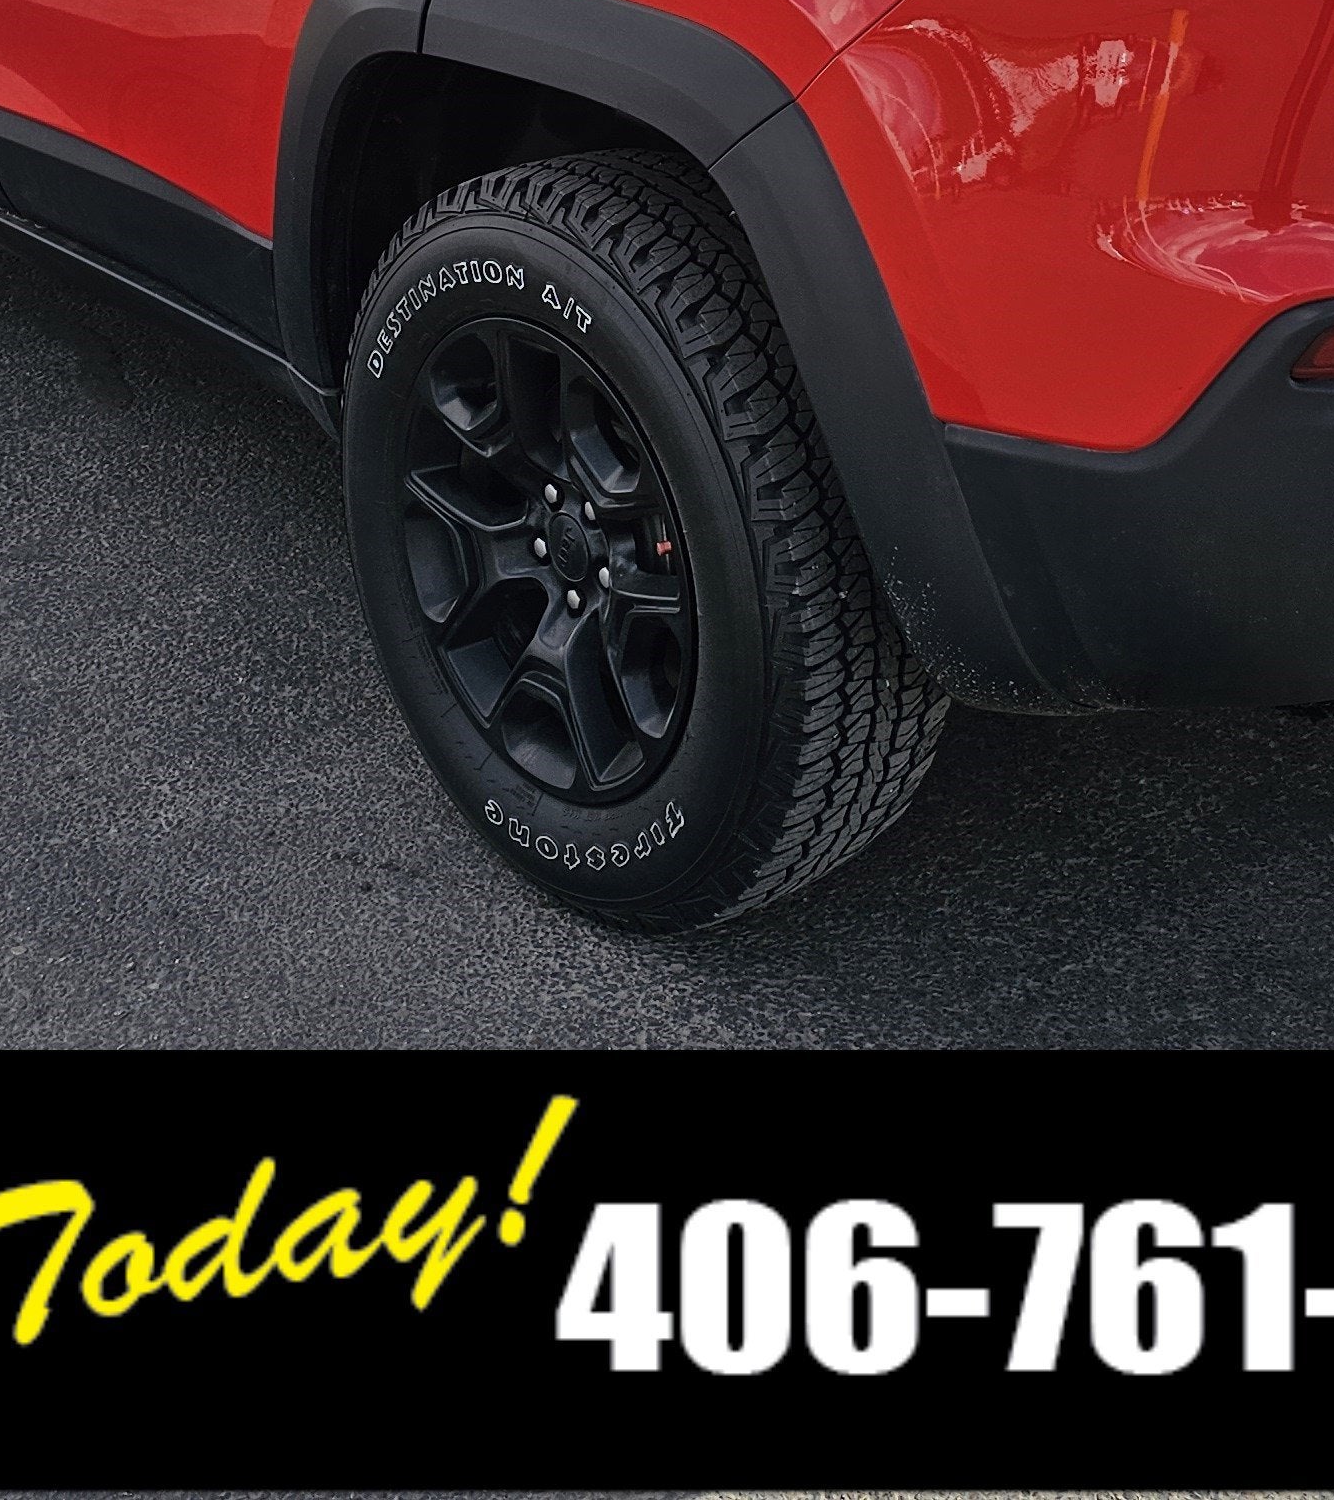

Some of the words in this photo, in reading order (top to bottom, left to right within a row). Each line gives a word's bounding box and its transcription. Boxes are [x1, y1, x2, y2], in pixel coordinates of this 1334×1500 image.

[367, 260, 525, 378] DESTINATION
[542, 284, 592, 334] A/T
[485, 800, 685, 870] Firestone
